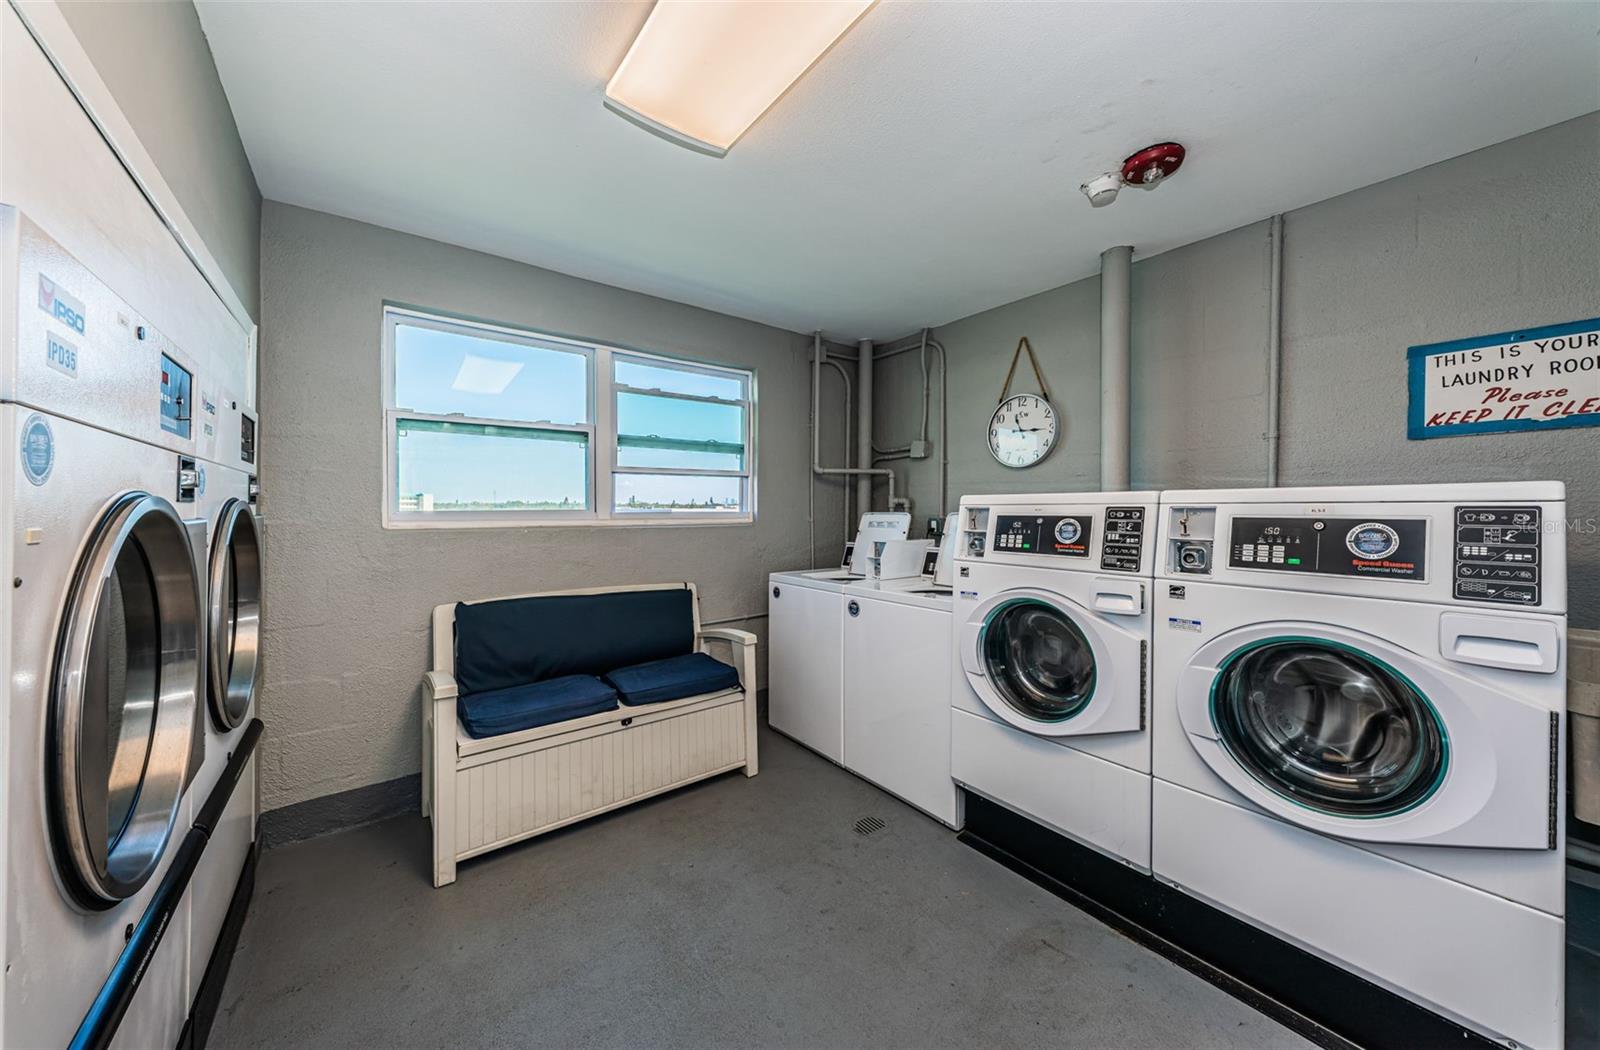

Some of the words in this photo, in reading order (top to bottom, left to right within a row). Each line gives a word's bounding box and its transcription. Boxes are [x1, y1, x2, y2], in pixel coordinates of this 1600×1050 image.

[54, 299, 84, 335] IPSO
[48, 339, 76, 370] IPD35
[1434, 350, 1482, 368] THIS
[1500, 345, 1521, 359] IS
[1534, 333, 1599, 353] YOUR
[1442, 363, 1534, 388] LAUNDRY
[1481, 386, 1568, 404] Please
[1006, 402, 1012, 412] 11
[1018, 397, 1027, 407] 12
[1035, 398, 1039, 408] 1
[1044, 407, 1051, 418] 2
[1426, 408, 1493, 427] KEEP
[1503, 404, 1529, 420] IT
[996, 414, 1005, 424] 10
[991, 429, 997, 438] 9
[1043, 439, 1049, 447] 4
[1033, 449, 1039, 460] 5
[1352, 559, 1381, 567] Speed
[1382, 561, 1414, 569] Queen
[1357, 565, 1390, 573] Commercial
